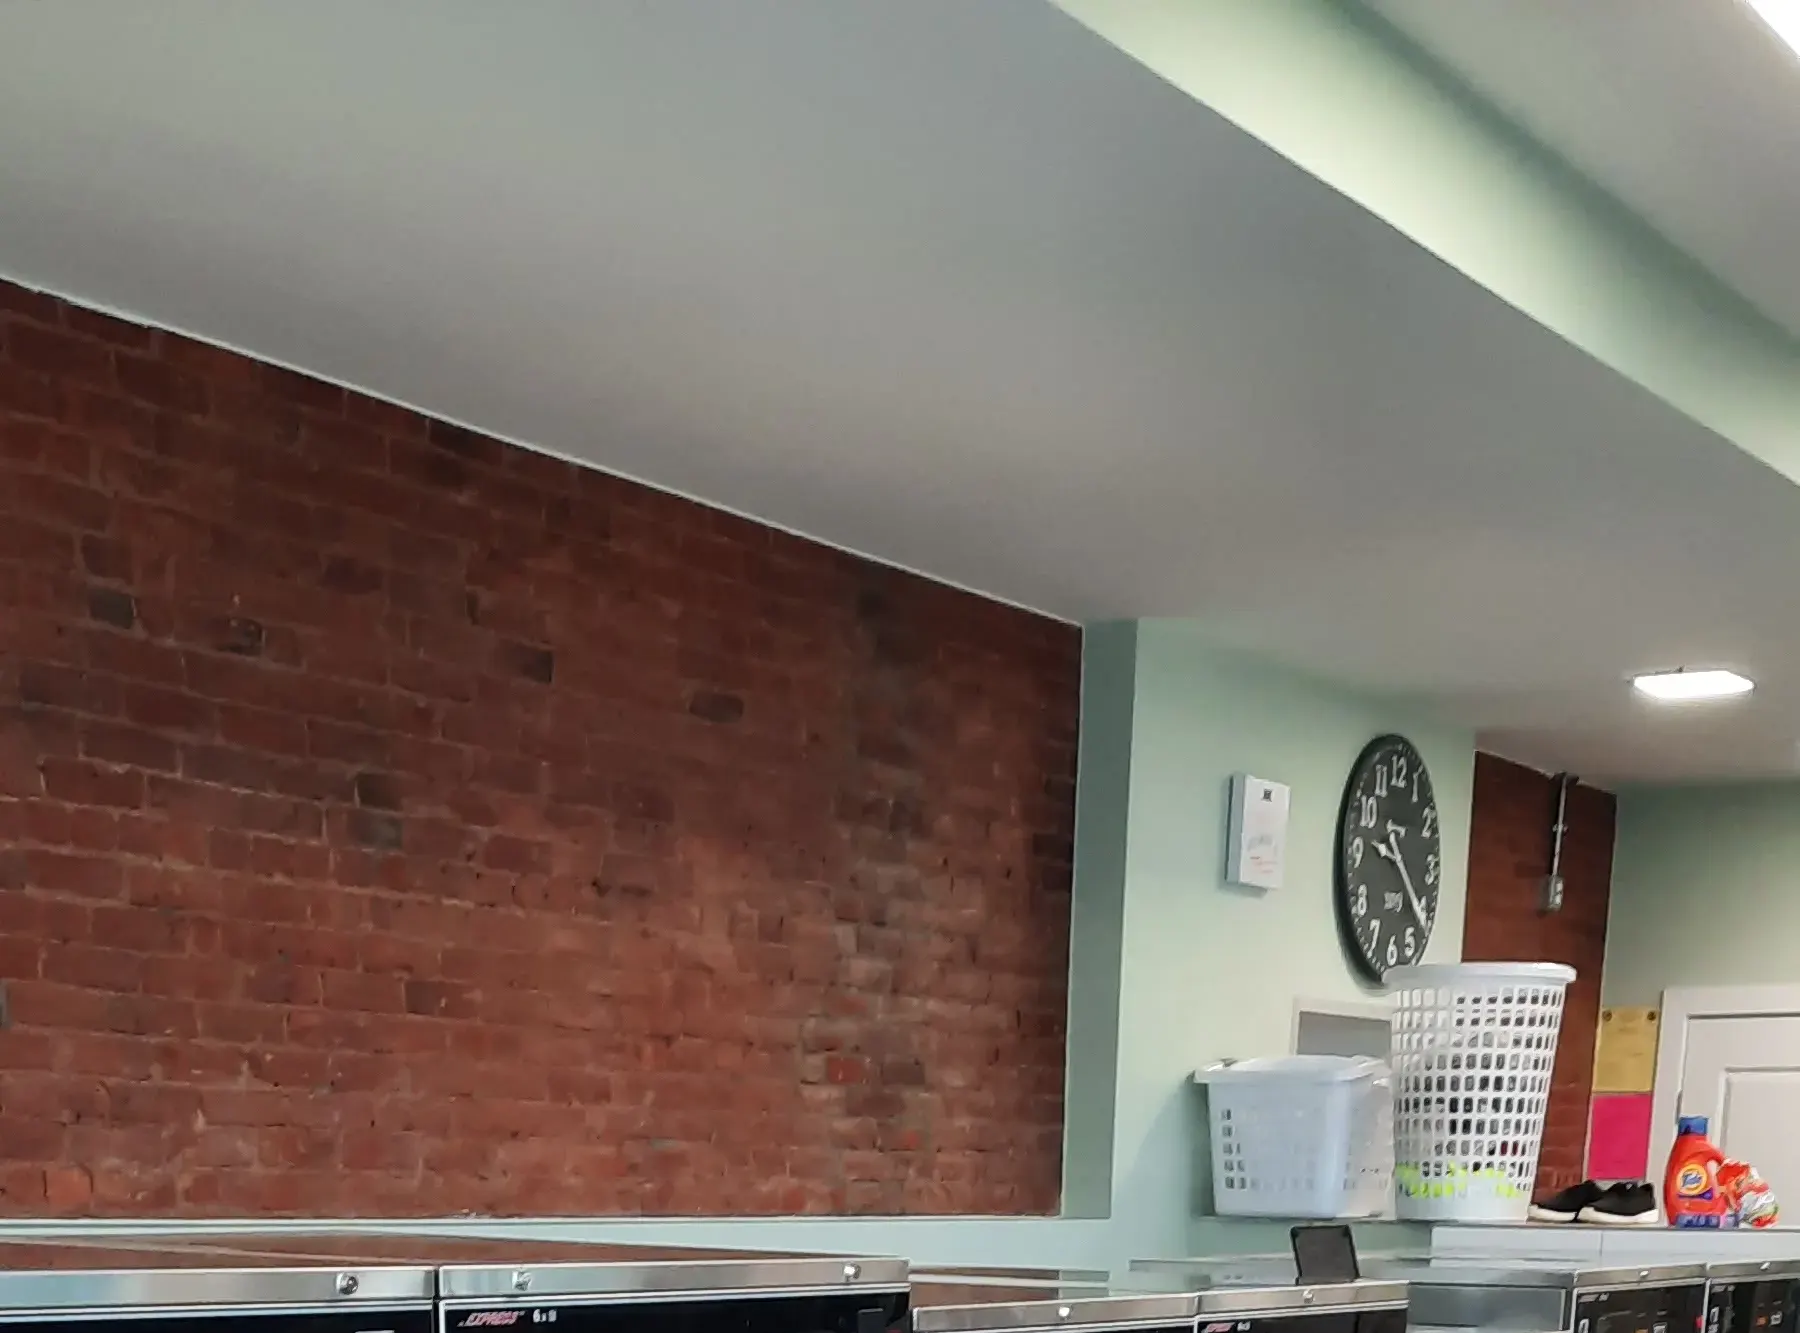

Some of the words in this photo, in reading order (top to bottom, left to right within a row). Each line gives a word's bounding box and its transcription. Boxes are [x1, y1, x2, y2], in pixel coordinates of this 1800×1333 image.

[1374, 764, 1388, 798] 11
[1390, 754, 1407, 788] 12
[1360, 794, 1378, 829] 10
[1421, 806, 1434, 838] 2
[1352, 836, 1364, 869] 9
[1424, 853, 1435, 886] 3
[1357, 883, 1367, 917] 8
[1366, 918, 1381, 959] 7
[1386, 934, 1398, 967] 6
[1404, 926, 1416, 958] 5
